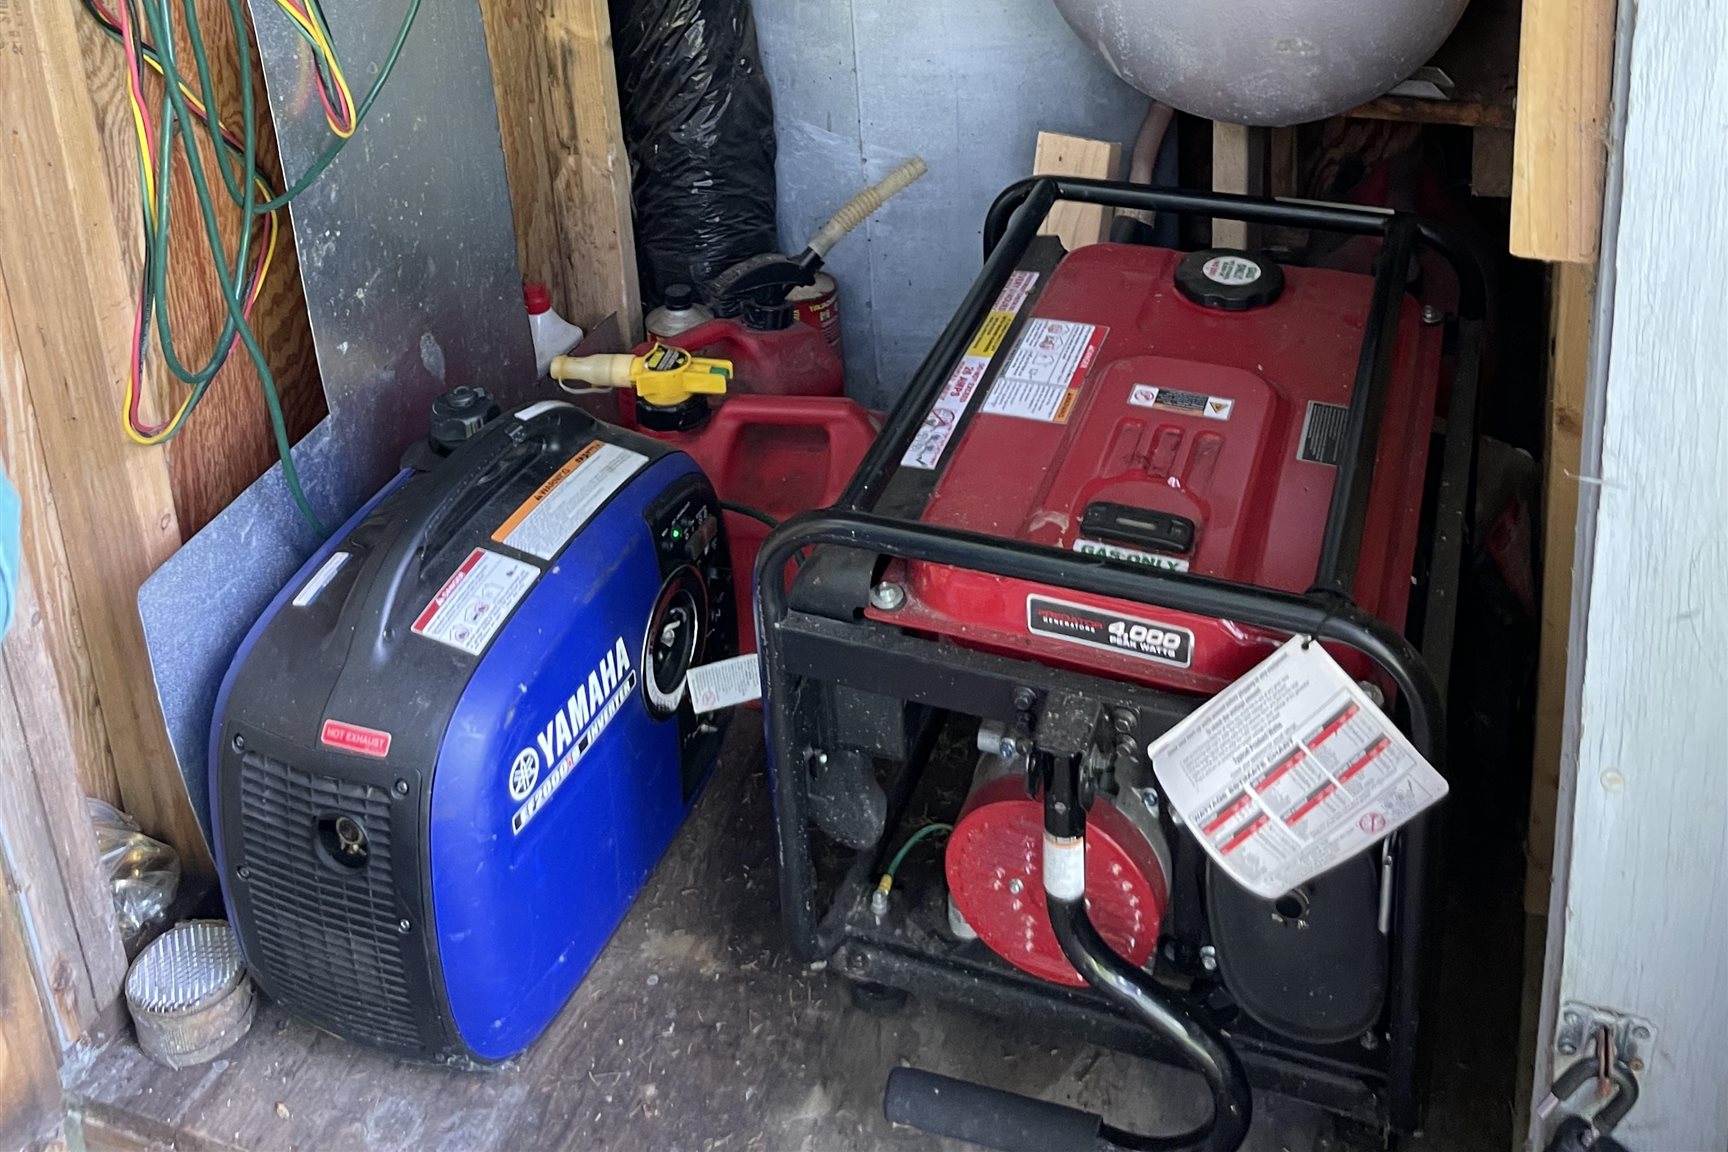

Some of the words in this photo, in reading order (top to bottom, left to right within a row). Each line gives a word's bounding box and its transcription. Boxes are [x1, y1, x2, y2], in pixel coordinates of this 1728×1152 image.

[1081, 544, 1121, 560] GAS
[1126, 554, 1179, 572] ONLY
[1042, 615, 1096, 634] GENERATORS
[1109, 635, 1137, 650] PEAK
[1140, 642, 1176, 658] WATTS
[536, 636, 631, 769] YAMAHA
[326, 726, 344, 739] HOT
[345, 730, 386, 748] EXHAUST
